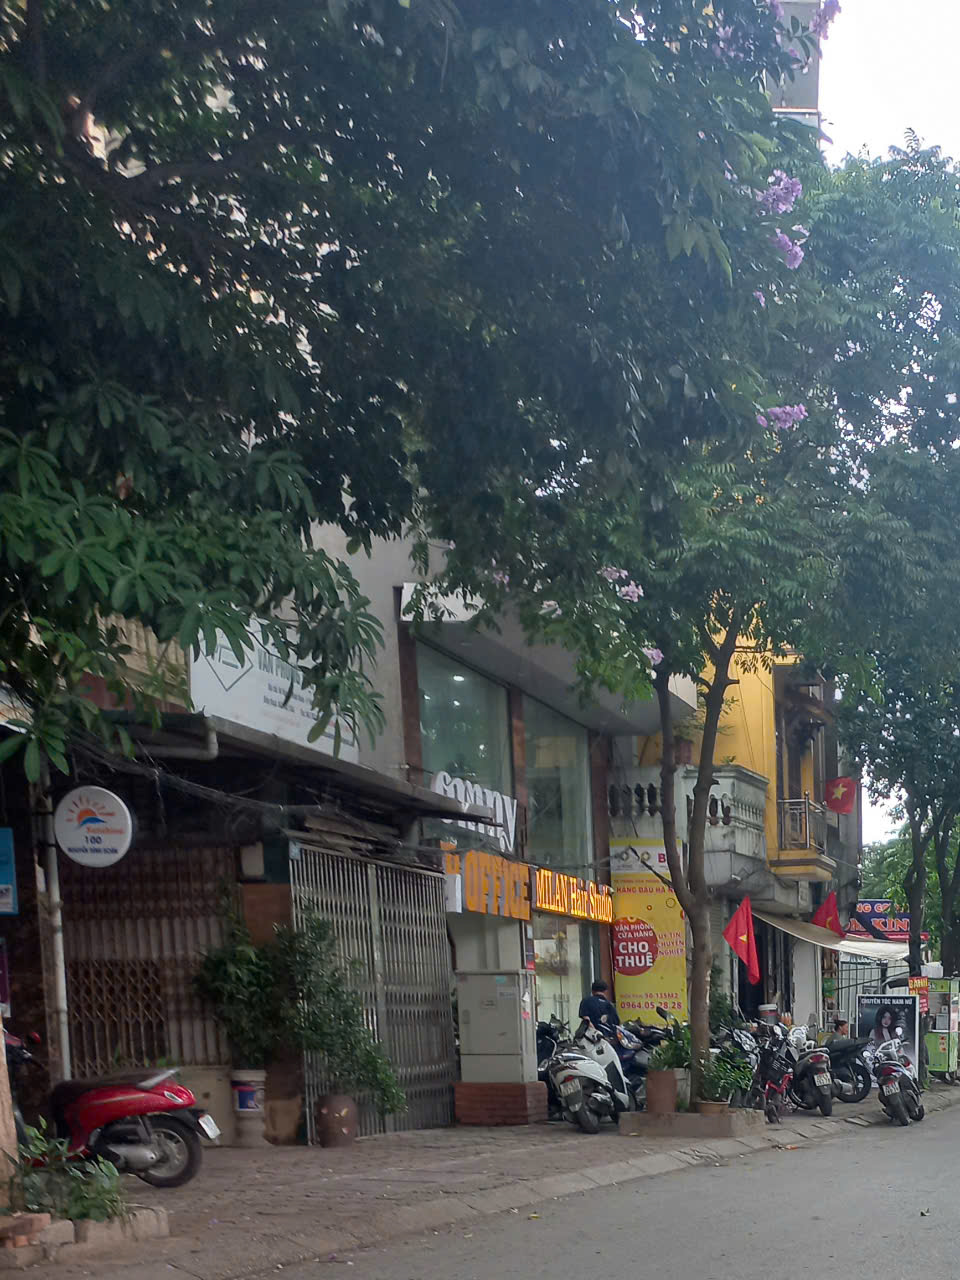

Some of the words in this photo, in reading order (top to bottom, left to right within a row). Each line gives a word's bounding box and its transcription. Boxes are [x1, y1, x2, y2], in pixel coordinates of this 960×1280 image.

[85, 836, 103, 844] 100
[465, 850, 530, 920] OFFICE
[536, 868, 568, 912] MILAN
[569, 876, 588, 917] Hair
[589, 881, 613, 923] Studio
[618, 941, 649, 953] CHO
[616, 952, 653, 968] THUÊ
